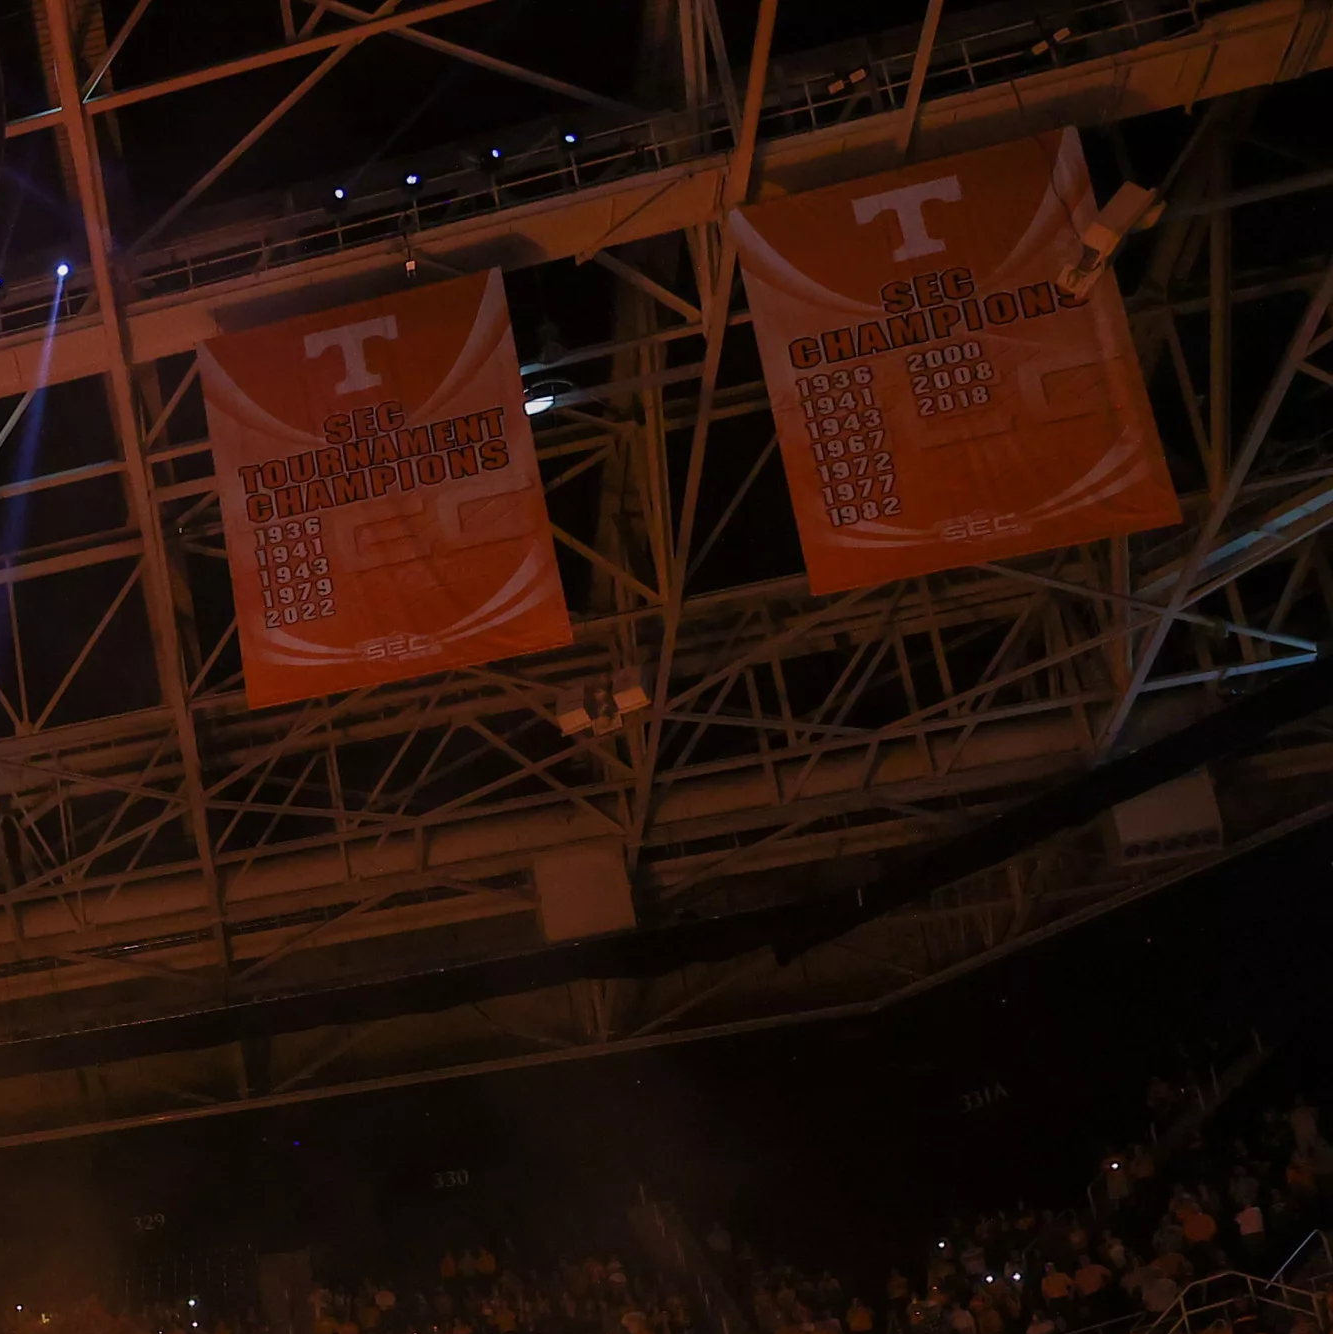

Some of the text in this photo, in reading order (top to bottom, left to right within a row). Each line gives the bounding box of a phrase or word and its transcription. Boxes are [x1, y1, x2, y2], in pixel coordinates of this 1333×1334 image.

[850, 174, 963, 263] T
[879, 266, 975, 315] SEC
[788, 279, 1090, 370] CHAMPIONS
[303, 313, 399, 396] T
[796, 341, 982, 398] 1936 2000
[801, 362, 995, 420] 1941 2008
[323, 400, 407, 446] SEC
[806, 384, 991, 441] 1943 2018
[238, 407, 506, 495] TOURNAMENT
[811, 429, 886, 463] 1967
[245, 439, 510, 525] CHAMPIONS
[816, 452, 895, 485] 1972
[821, 474, 897, 507] 1977
[826, 496, 902, 528] 1982
[939, 512, 1020, 541] SEC
[254, 517, 322, 548] 1936
[255, 537, 325, 568] 1941
[259, 558, 330, 589] 1943
[262, 578, 334, 610] 1979
[265, 598, 336, 630] 2022
[433, 1169, 469, 1188] 330
[133, 1213, 165, 1232] 329
